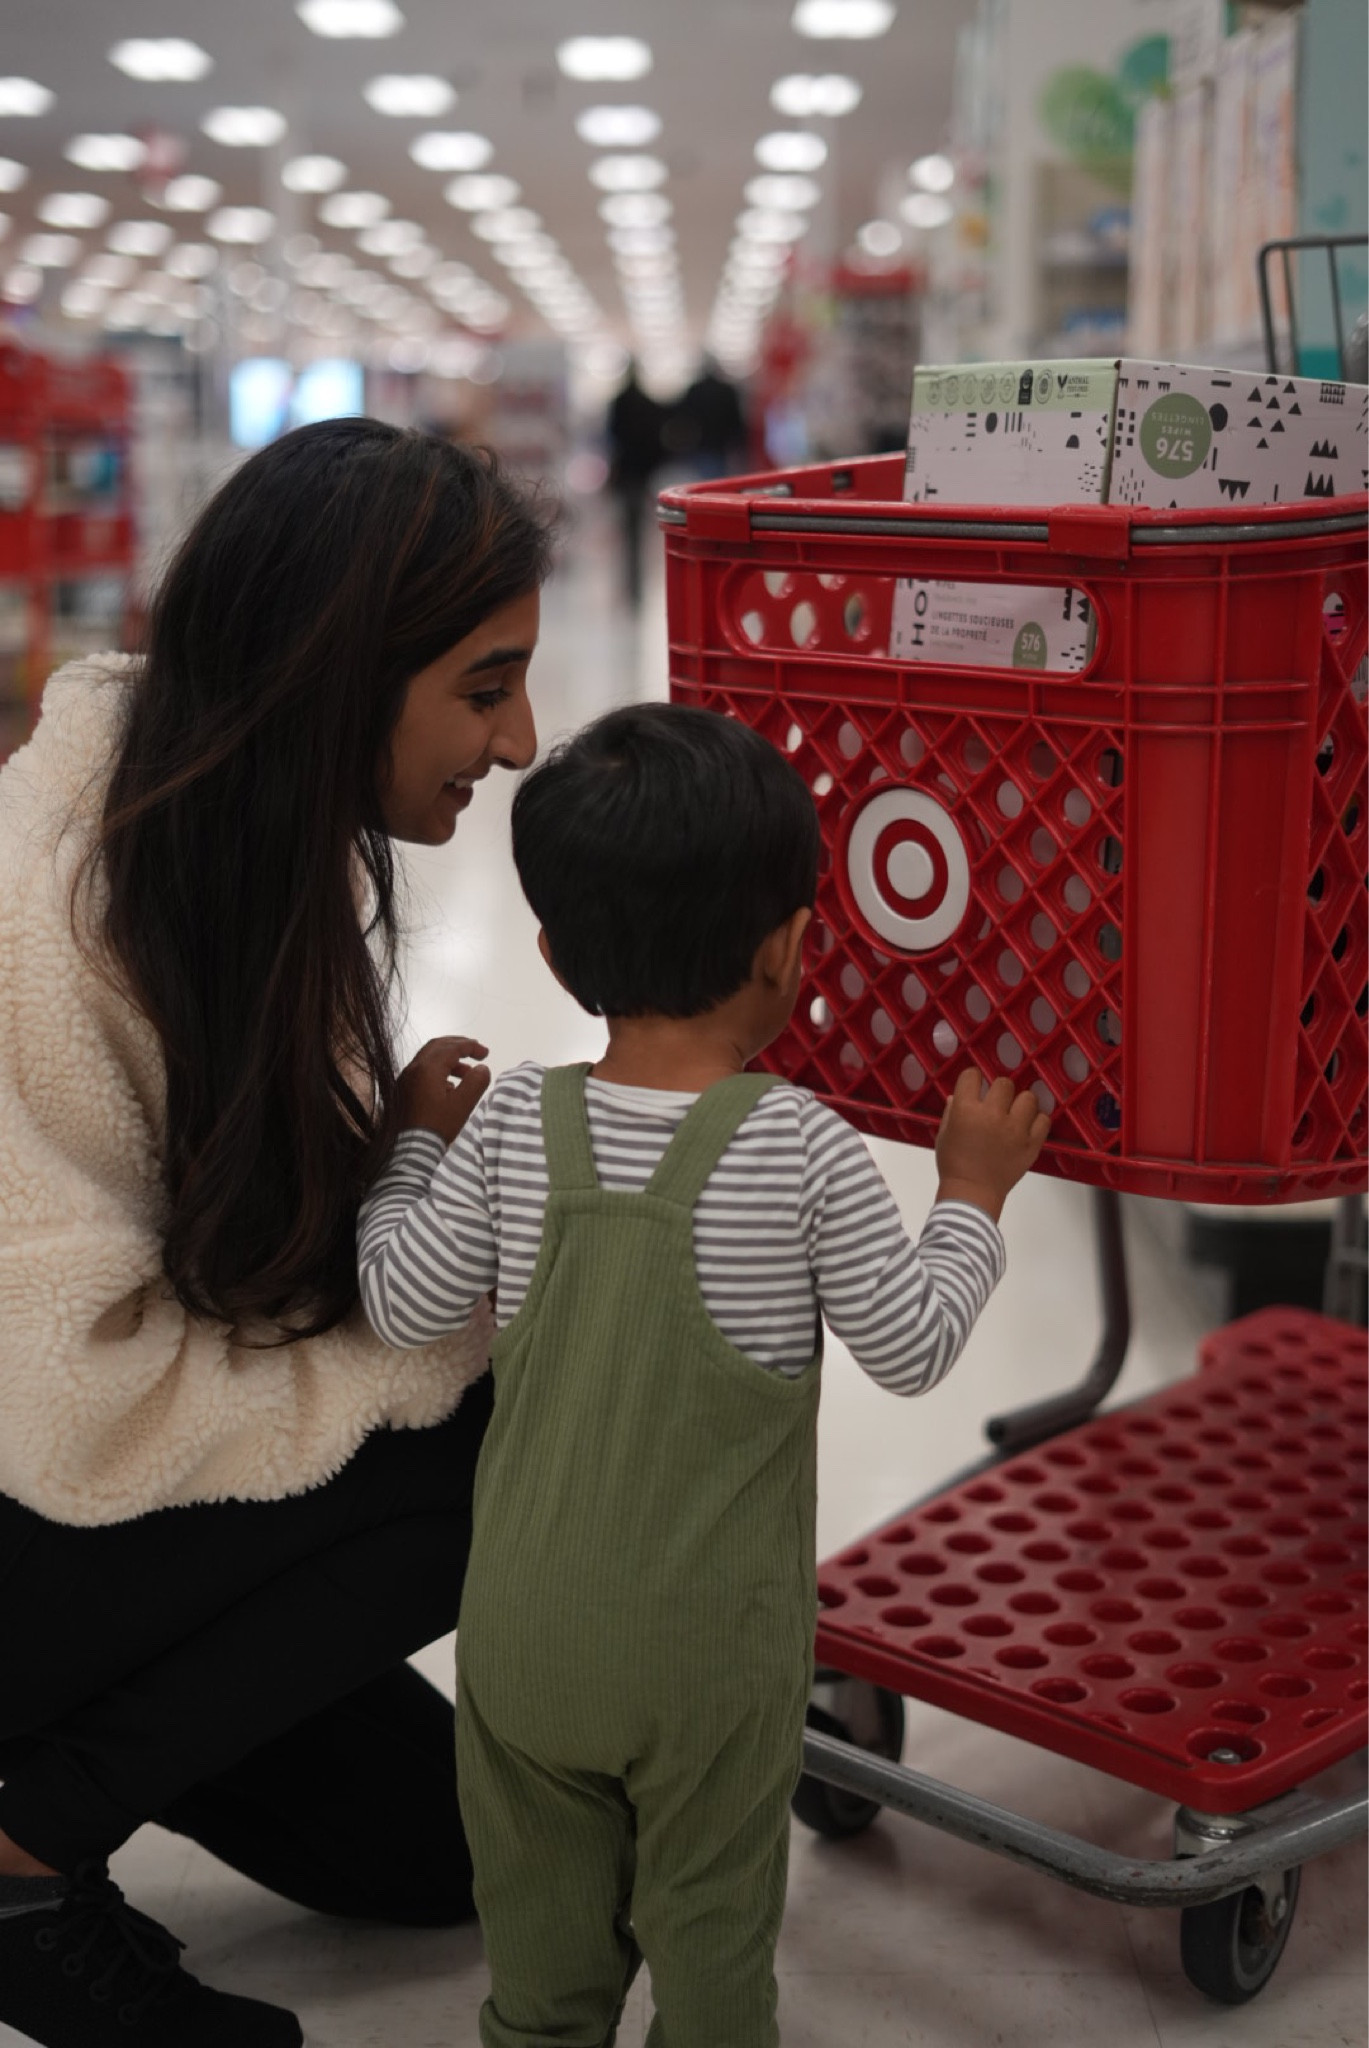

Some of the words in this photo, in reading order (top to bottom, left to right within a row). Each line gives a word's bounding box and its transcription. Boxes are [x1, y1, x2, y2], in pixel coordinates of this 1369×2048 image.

[1156, 437, 1194, 462] 576
[970, 614, 1014, 629] SOUCIEUSES
[1021, 632, 1041, 652] 576
